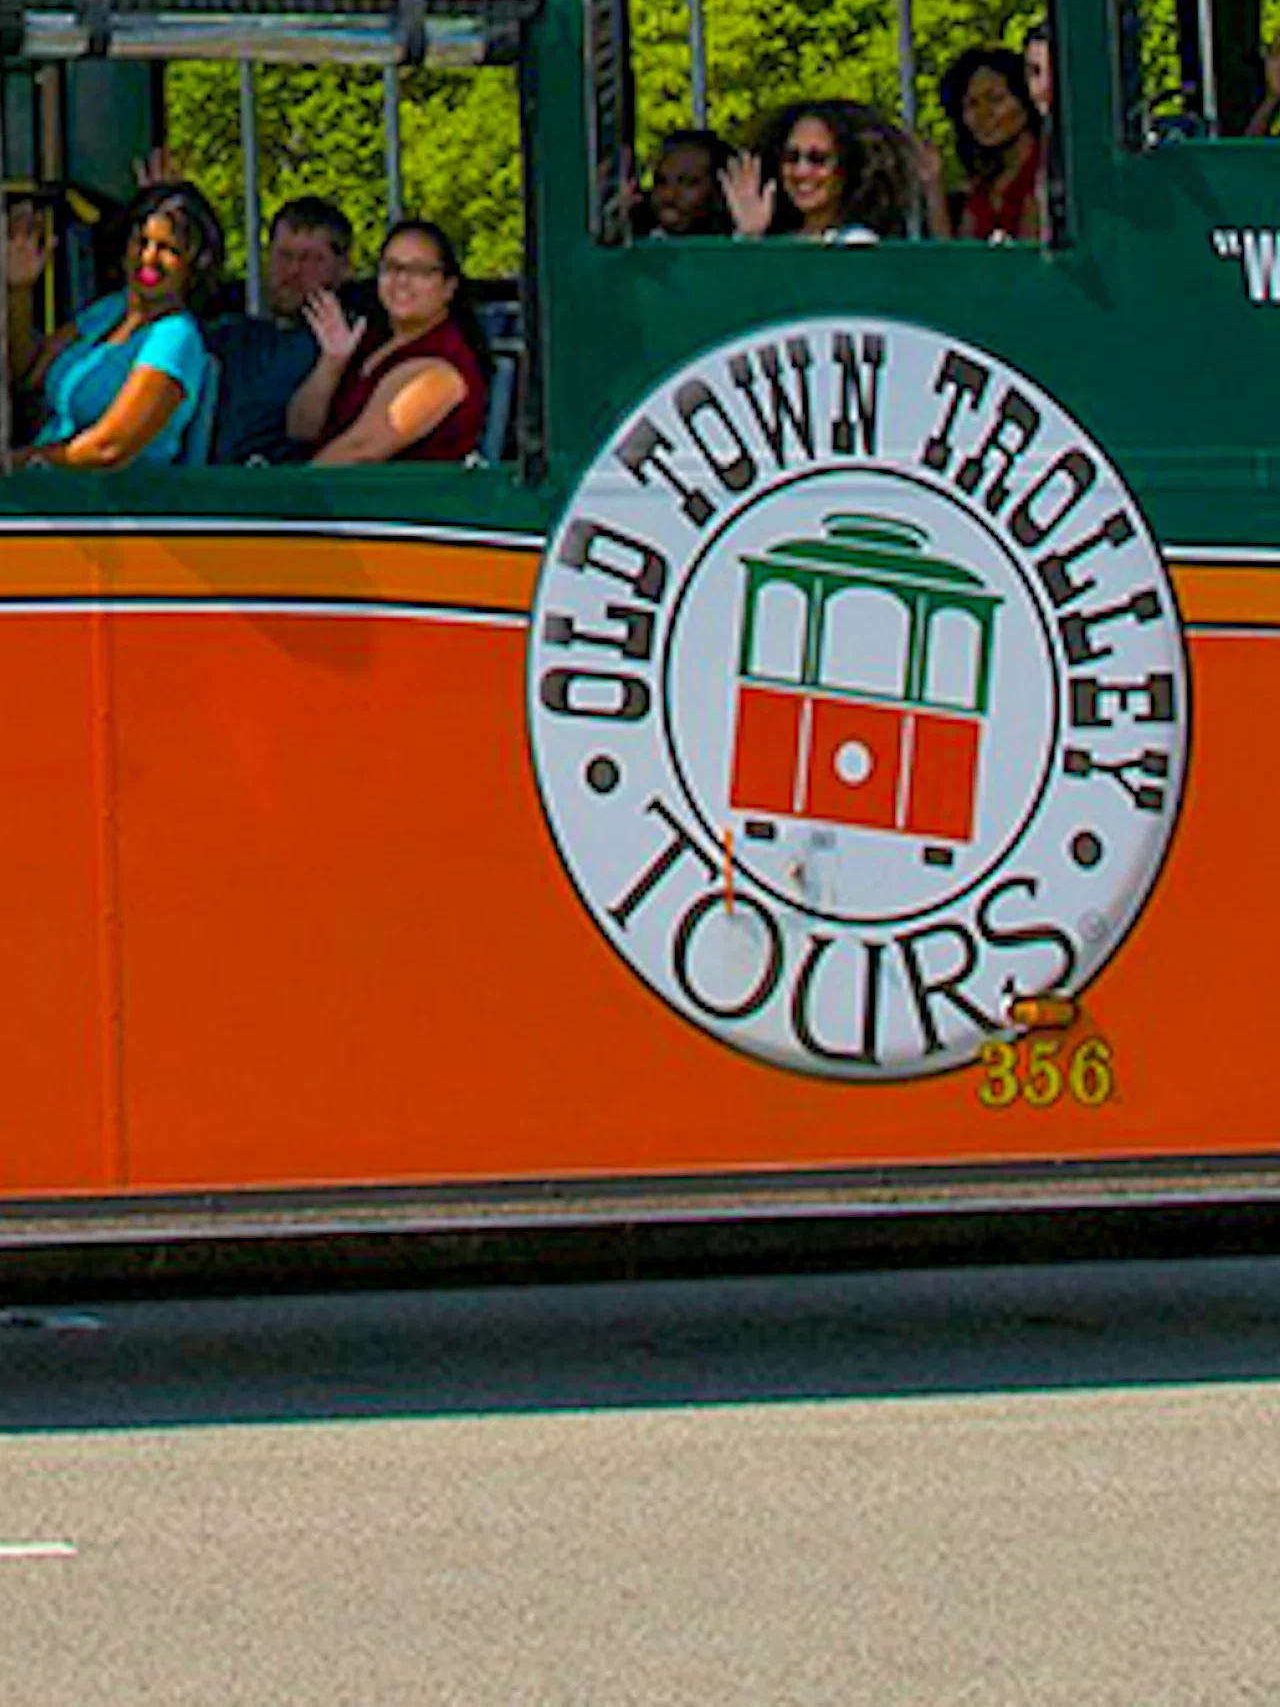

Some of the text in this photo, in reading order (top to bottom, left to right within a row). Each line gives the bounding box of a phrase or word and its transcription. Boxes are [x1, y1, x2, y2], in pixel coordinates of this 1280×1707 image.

[540, 331, 1179, 815] OLD TOWN TROLLEY
[607, 797, 1080, 1067] TOURS
[978, 1038, 1114, 1108] 356
